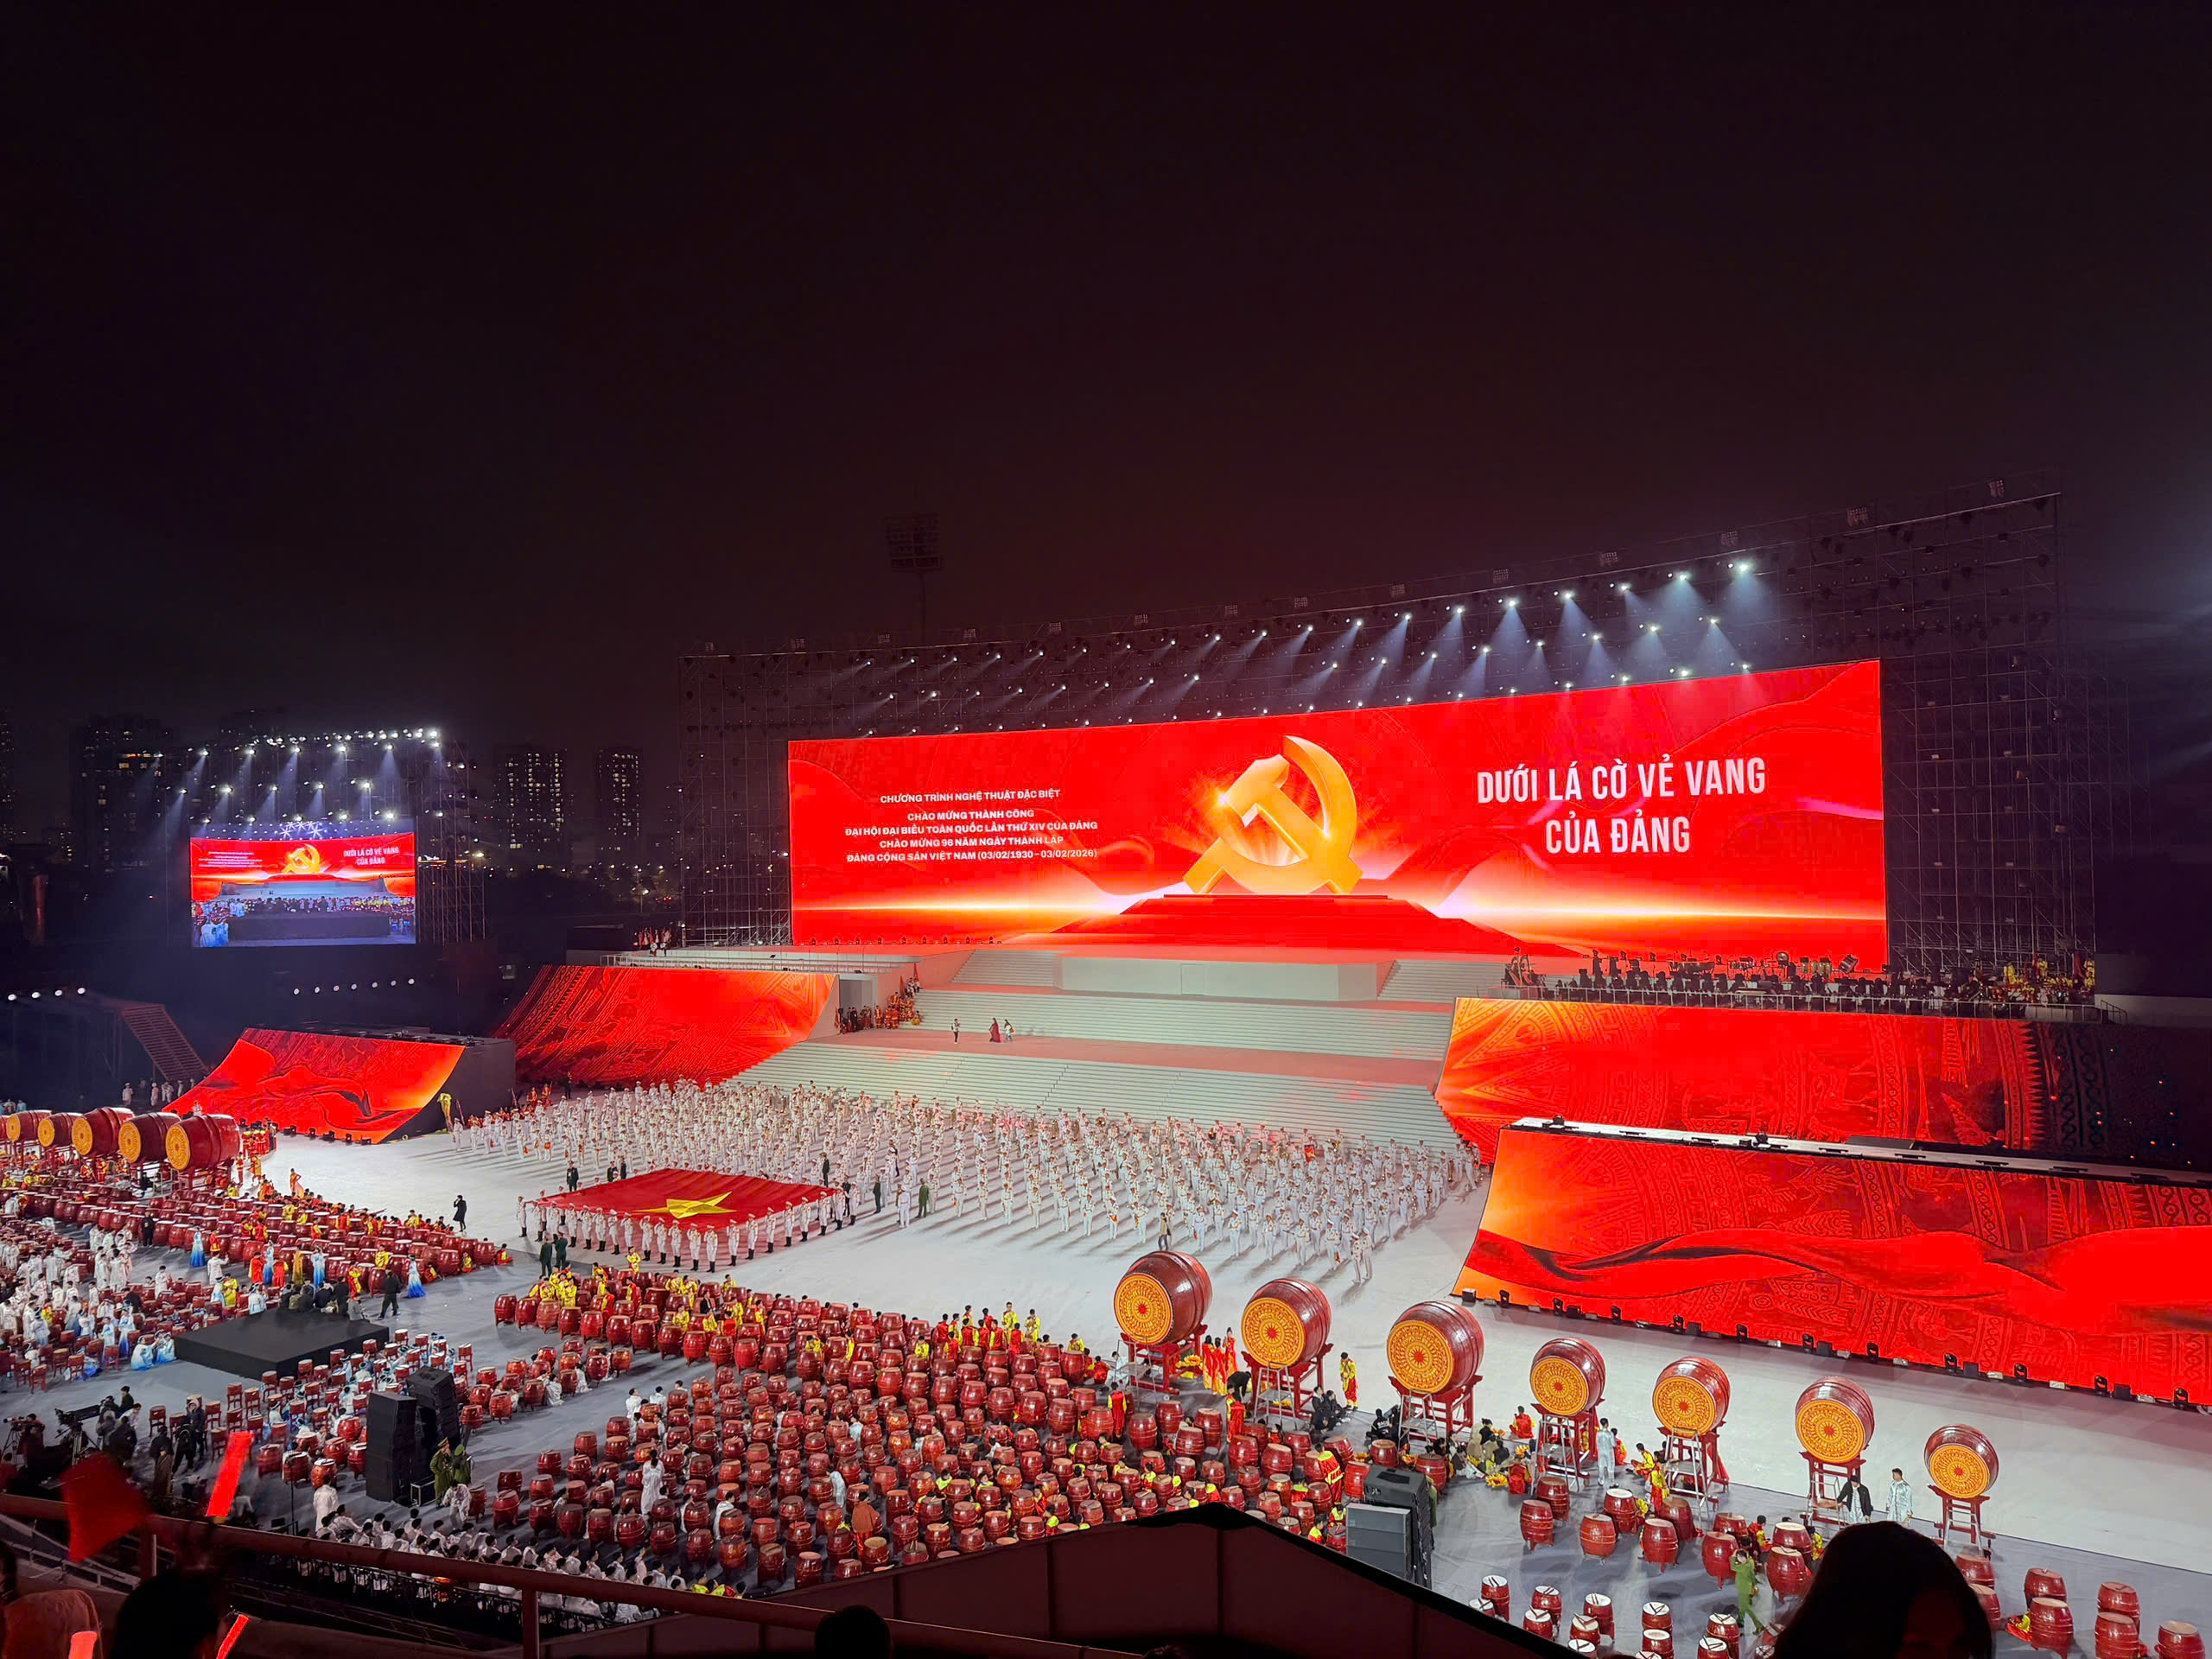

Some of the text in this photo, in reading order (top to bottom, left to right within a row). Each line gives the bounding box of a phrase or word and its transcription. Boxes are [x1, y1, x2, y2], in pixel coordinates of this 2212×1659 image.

[1478, 753, 1765, 803] DƯỚI LÁ CỜ VẺ VANG
[880, 788, 1060, 803] CHƯƠNG TRÌNH NGHỆ THUẬT ĐẶC BIỆT
[907, 809, 1034, 821] CHÀO MỪNG THÀNH CÔNG
[845, 820, 1098, 837] ĐẠI HỘI ĐẠI BIỂU TOÀN QUỐC LẦN THỨ XIV CỦA ĐẢNG
[1546, 808, 1690, 854] CỦA ĐẢNG
[880, 838, 908, 848] CHÀO
[910, 837, 940, 848] MỪNG
[955, 836, 977, 846] NĂM
[979, 836, 1007, 846] NGÀY
[1007, 835, 1043, 845] THÀNH
[847, 853, 875, 862] ĐẢNG
[876, 852, 906, 863] CỘNG
[907, 851, 928, 861] SẢN
[929, 851, 952, 861] VIỆT
[977, 850, 1033, 861] (03/02/1930
[1040, 849, 1098, 858] 03/02/2026)
